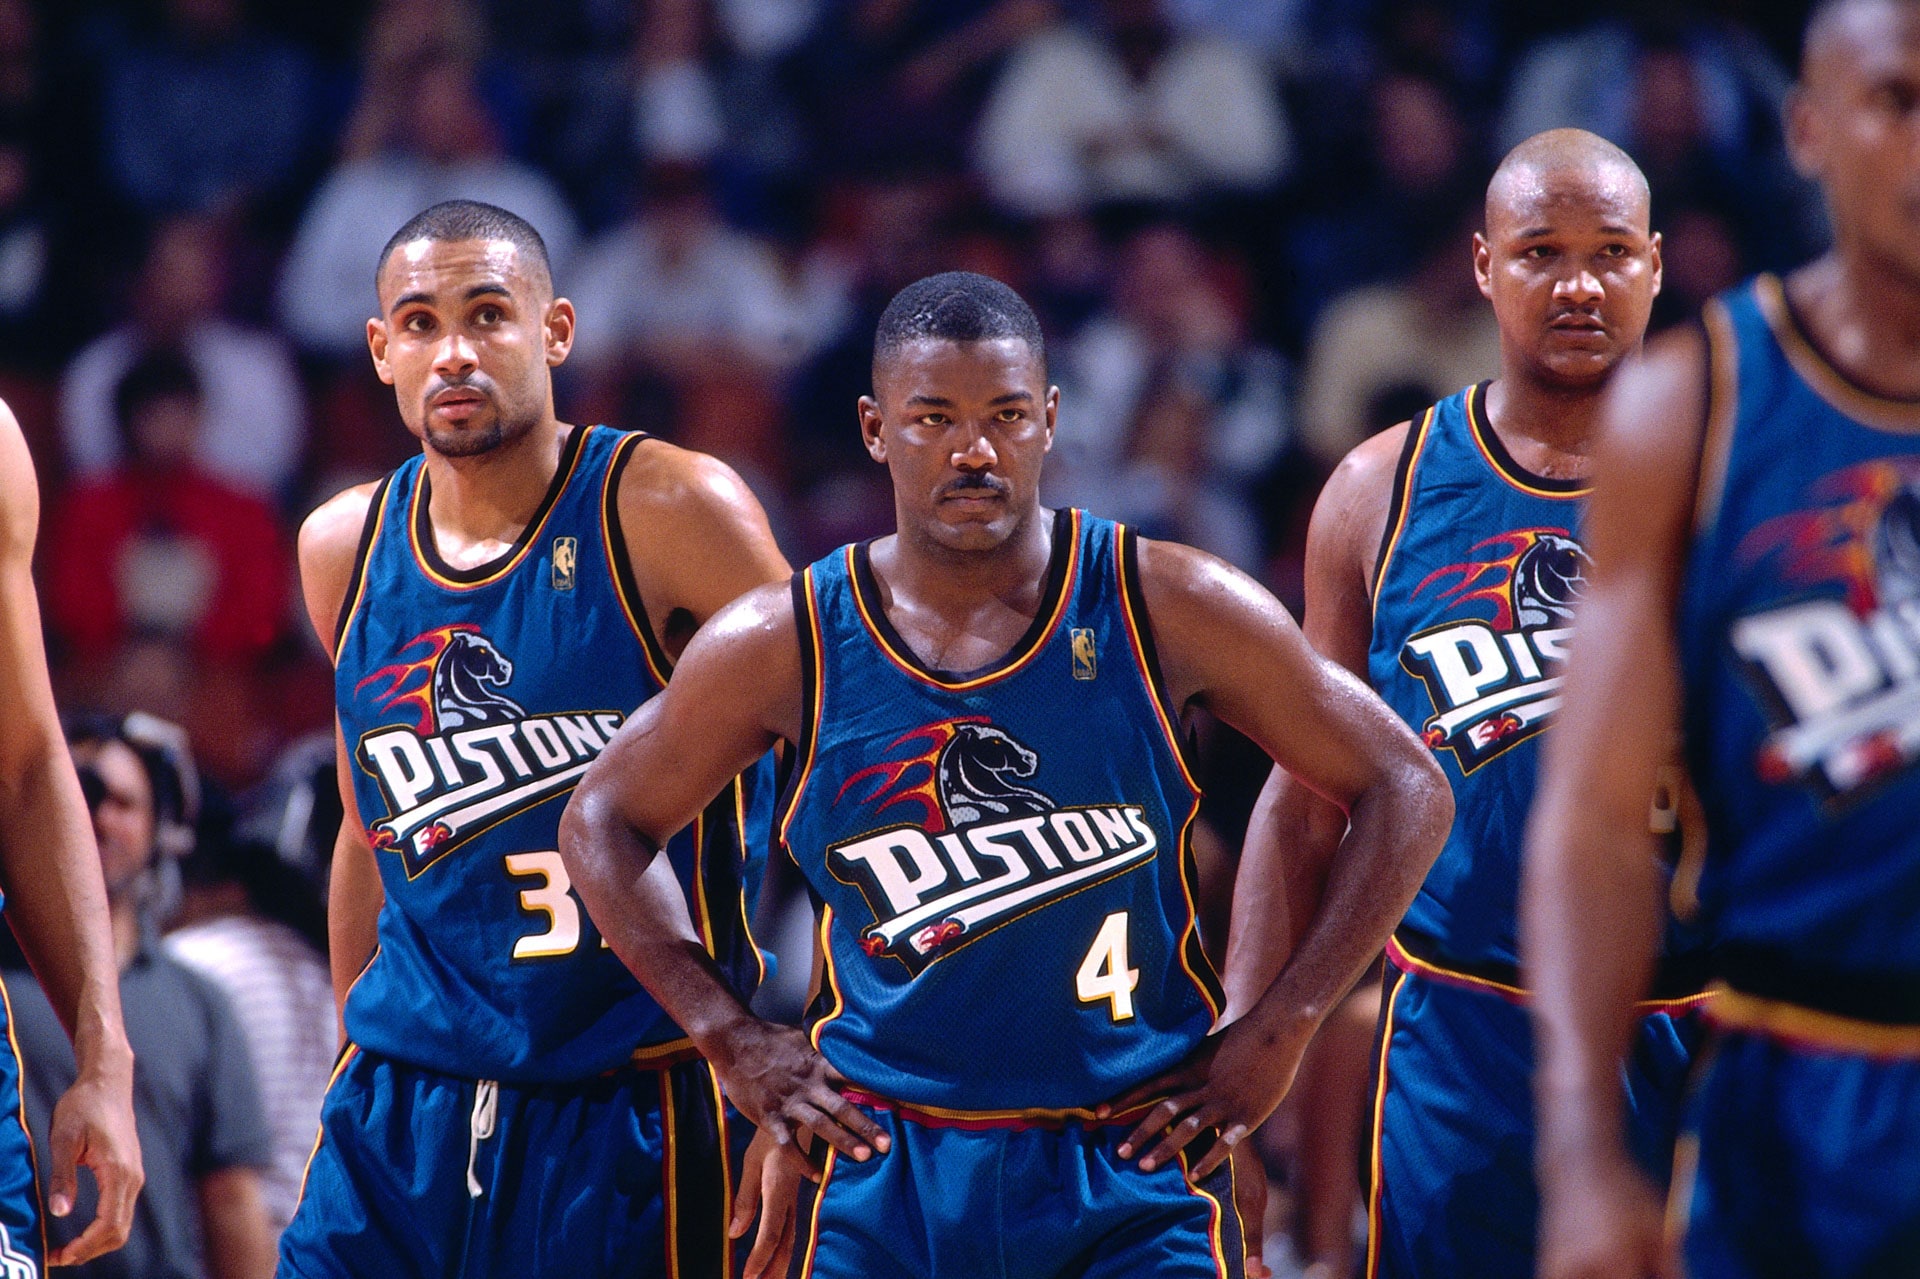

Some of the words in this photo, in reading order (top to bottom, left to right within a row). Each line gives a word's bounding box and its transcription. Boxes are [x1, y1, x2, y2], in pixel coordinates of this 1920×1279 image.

[505, 851, 609, 959] 3
[833, 807, 1157, 924] PISTONS
[1076, 911, 1139, 1021] 4
